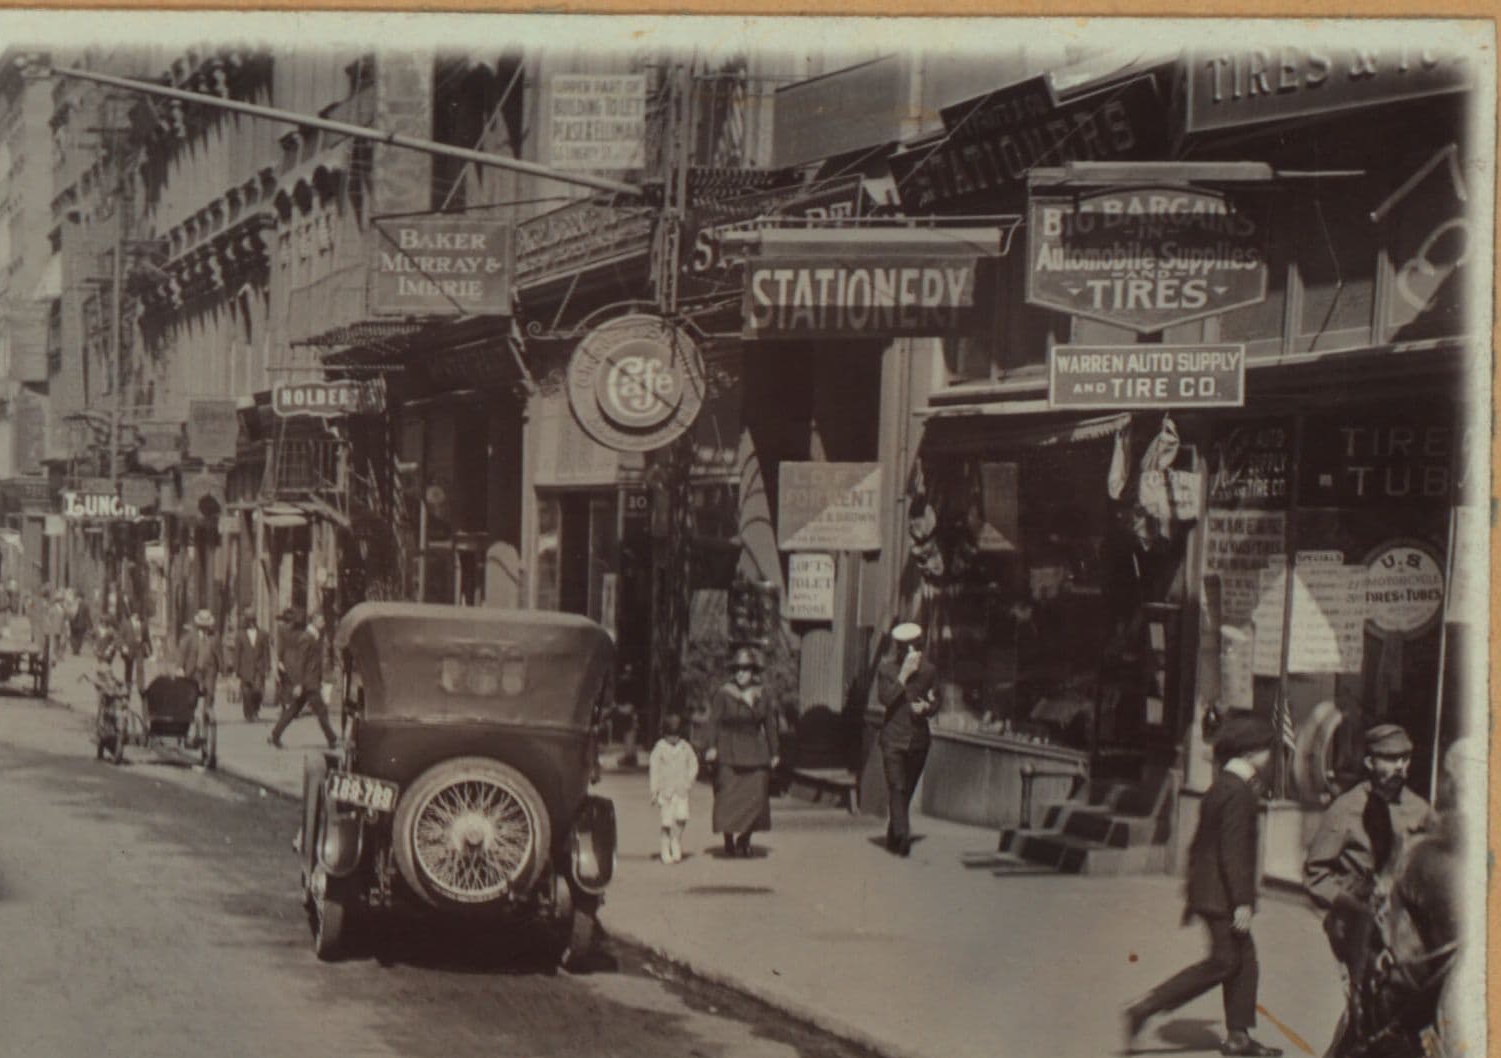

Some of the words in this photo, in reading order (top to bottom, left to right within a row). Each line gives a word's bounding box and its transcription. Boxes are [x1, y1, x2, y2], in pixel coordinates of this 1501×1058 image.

[1206, 46, 1331, 103] TIRES
[1042, 204, 1095, 238] BIG
[1102, 195, 1256, 237] BARGAINS
[399, 229, 486, 250] BAKER
[380, 253, 481, 273] MURRAY
[485, 256, 503, 274] &
[1036, 243, 1155, 271] Automobile
[1159, 241, 1261, 276] Supplies
[751, 268, 970, 329] STATIONERY
[1086, 279, 1207, 309] TIRES
[1057, 354, 1131, 373] WARREN
[1136, 353, 1172, 373] AUTO
[1177, 351, 1240, 372] SUPPLY
[1073, 383, 1106, 394] AND
[1111, 378, 1168, 397] TIRE
[1365, 591, 1398, 603] TIRES
[1406, 589, 1444, 602] TUBES
